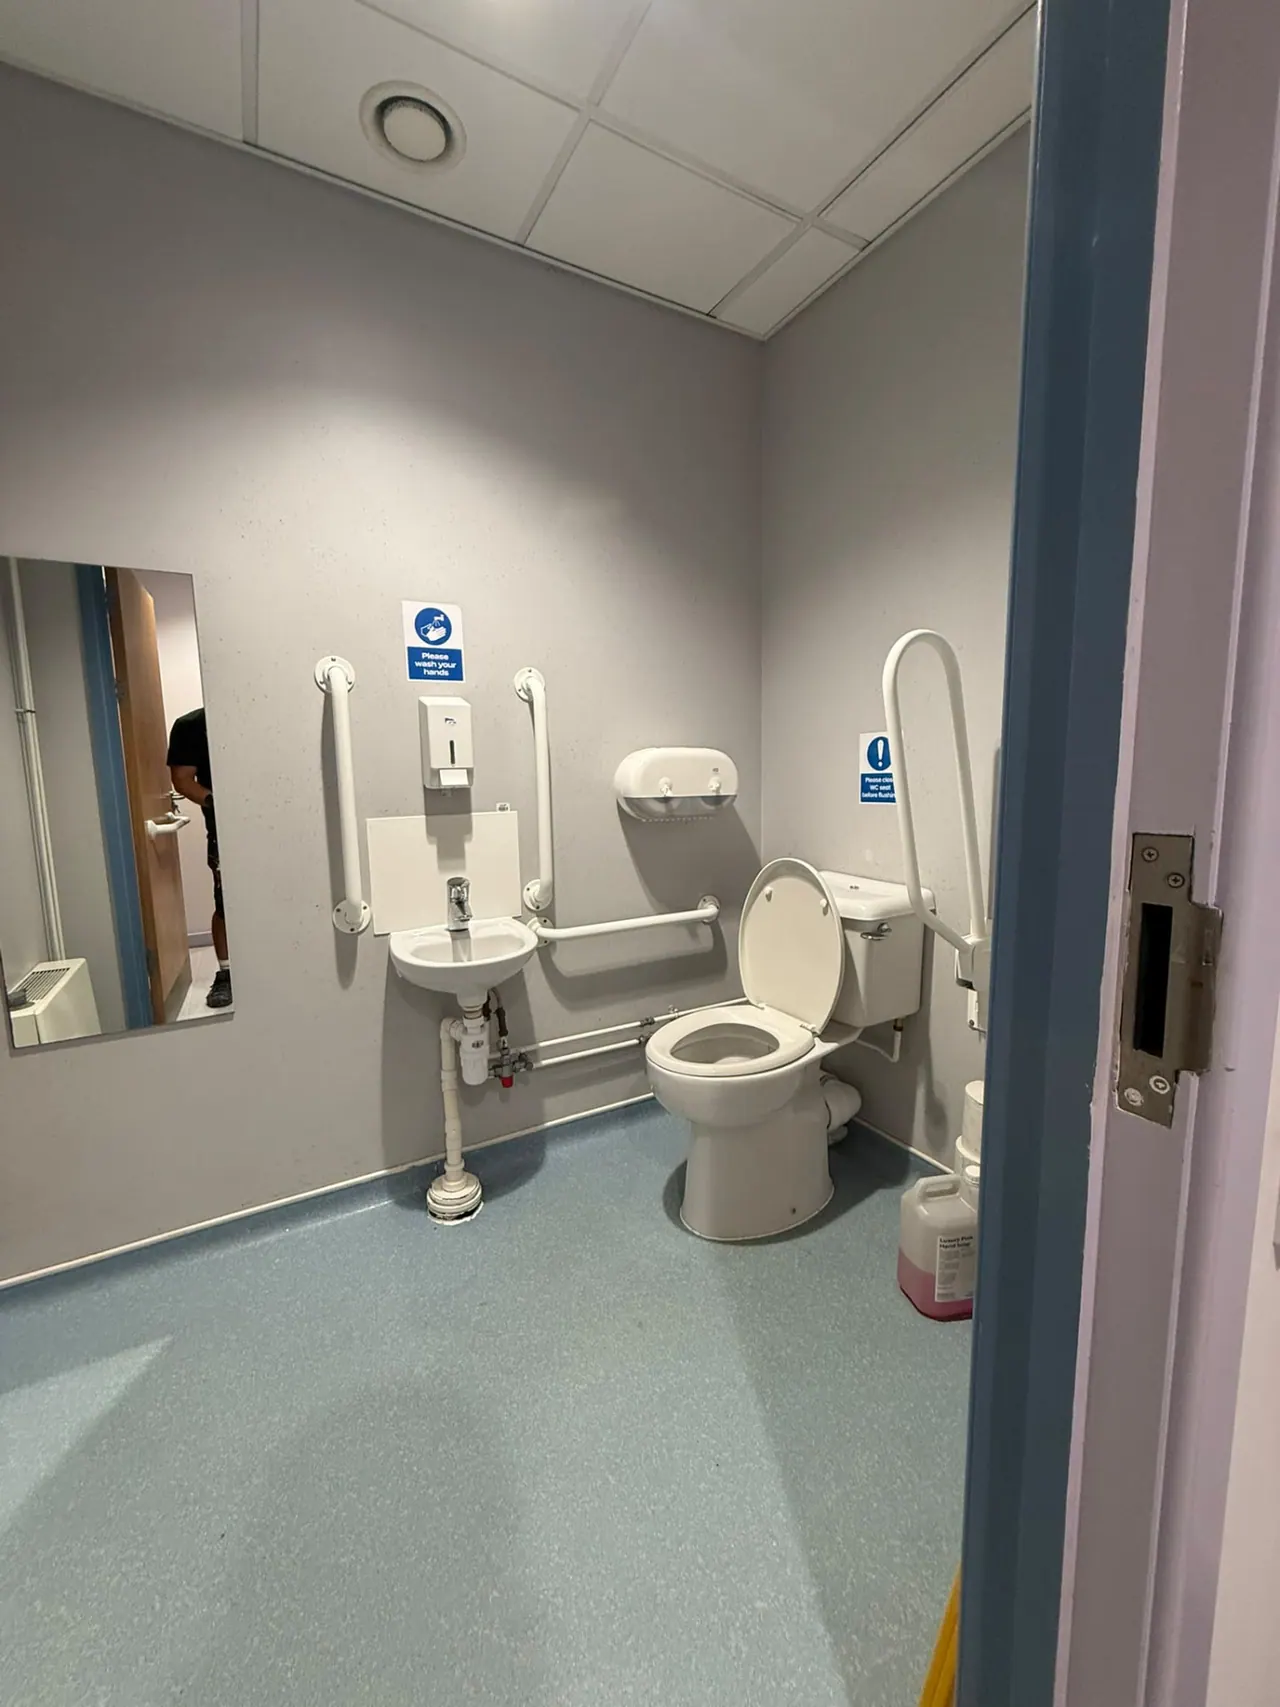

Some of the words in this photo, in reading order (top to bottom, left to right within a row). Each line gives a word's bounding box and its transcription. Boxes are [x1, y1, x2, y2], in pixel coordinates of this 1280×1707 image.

[421, 652, 449, 661] Please
[437, 662, 457, 670] your
[423, 668, 449, 676] hands
